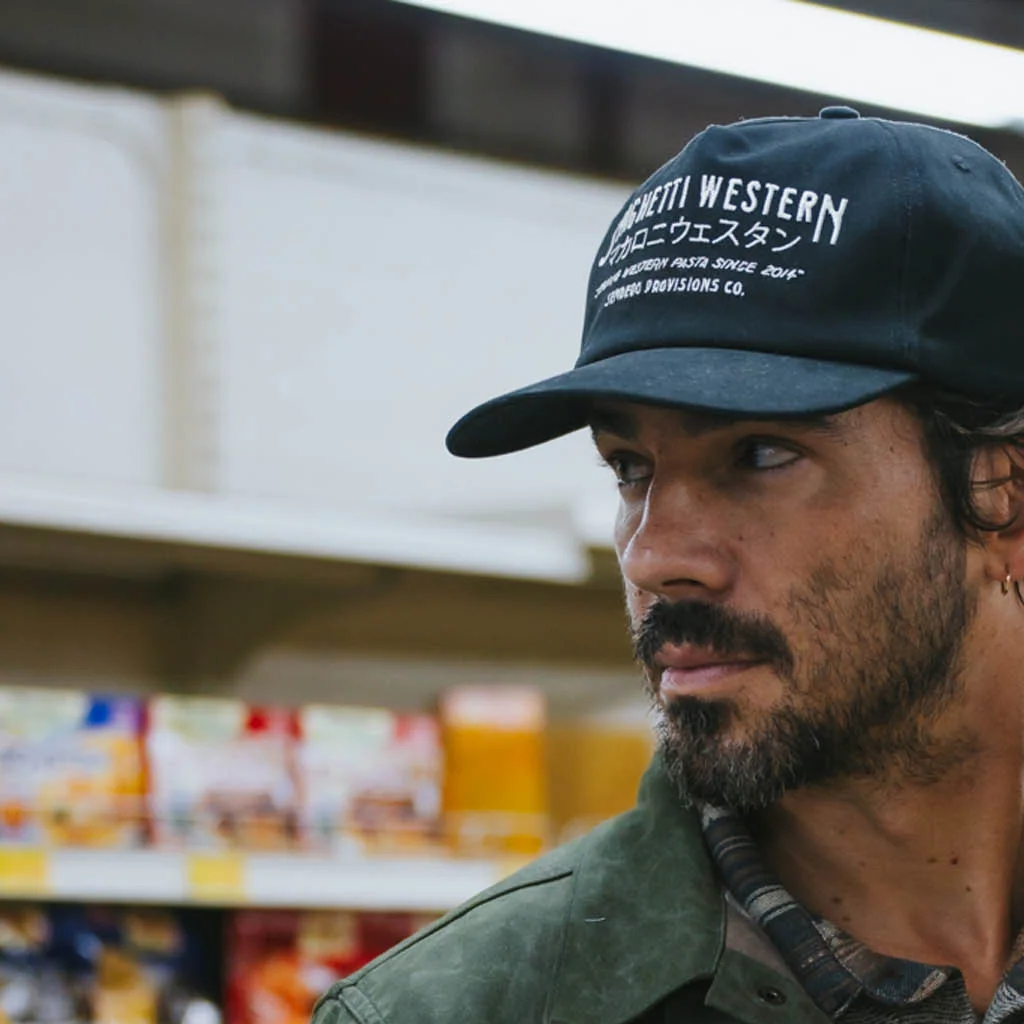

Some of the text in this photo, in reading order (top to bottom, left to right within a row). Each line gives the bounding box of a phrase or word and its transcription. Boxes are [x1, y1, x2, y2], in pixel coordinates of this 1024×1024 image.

[598, 174, 849, 267] GHETTI WESTERN
[670, 256, 708, 269] PASTA
[711, 257, 757, 273] SINCE
[643, 276, 720, 294] PROVISIONS
[724, 280, 745, 297] CO.
